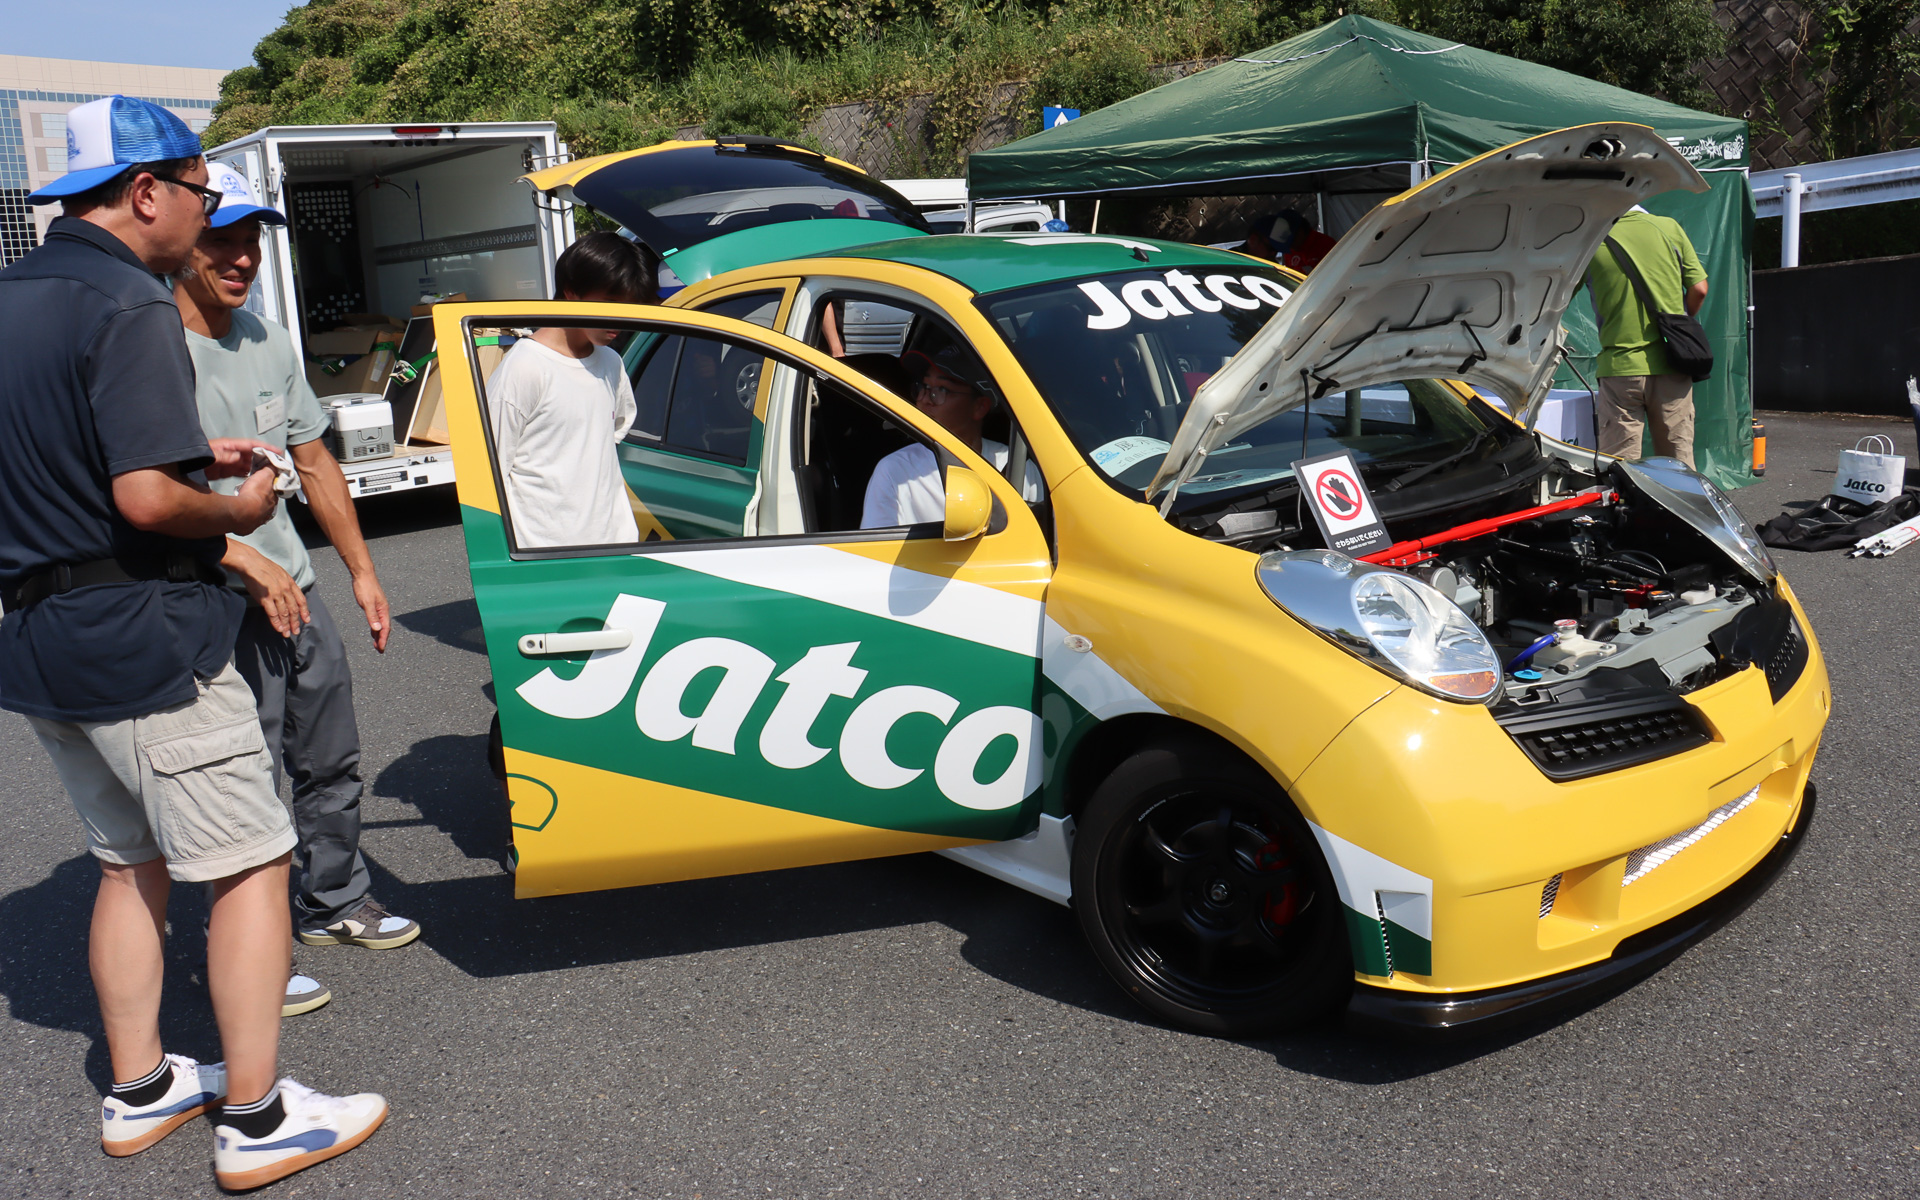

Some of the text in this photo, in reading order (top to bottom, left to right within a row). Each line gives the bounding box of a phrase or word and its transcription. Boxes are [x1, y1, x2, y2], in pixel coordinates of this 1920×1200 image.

[1077, 269, 1293, 330] Jatco
[1843, 478, 1885, 493] Jatco
[1335, 529, 1383, 548] さわらないでください
[515, 593, 1043, 810] Jatco
